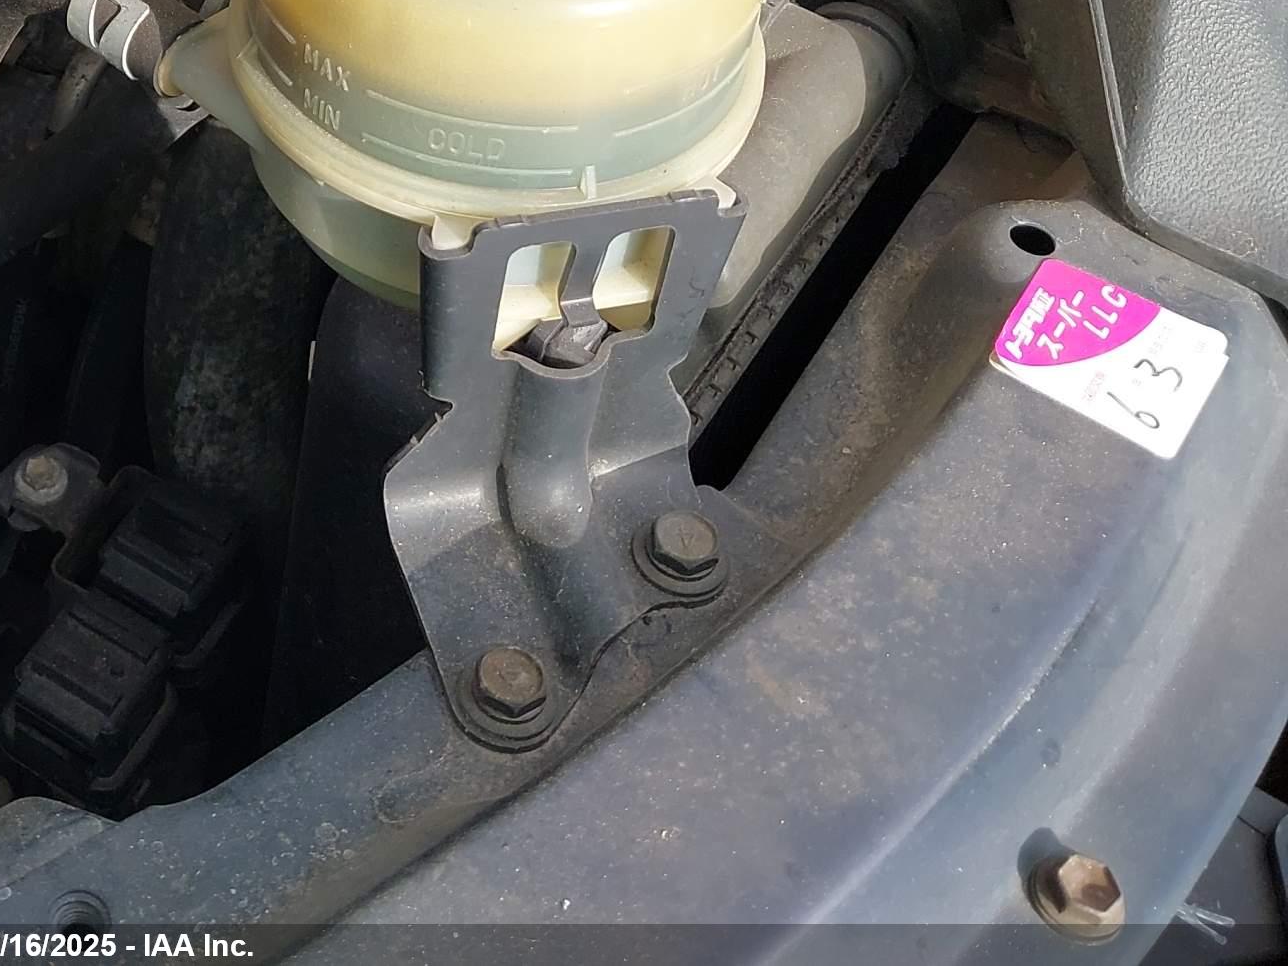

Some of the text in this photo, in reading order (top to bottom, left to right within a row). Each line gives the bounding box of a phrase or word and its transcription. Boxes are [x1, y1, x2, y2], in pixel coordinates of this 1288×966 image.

[302, 41, 352, 92] MAX
[302, 87, 342, 132] MIN
[426, 127, 506, 163] COLD
[1082, 283, 1128, 341] LLC
